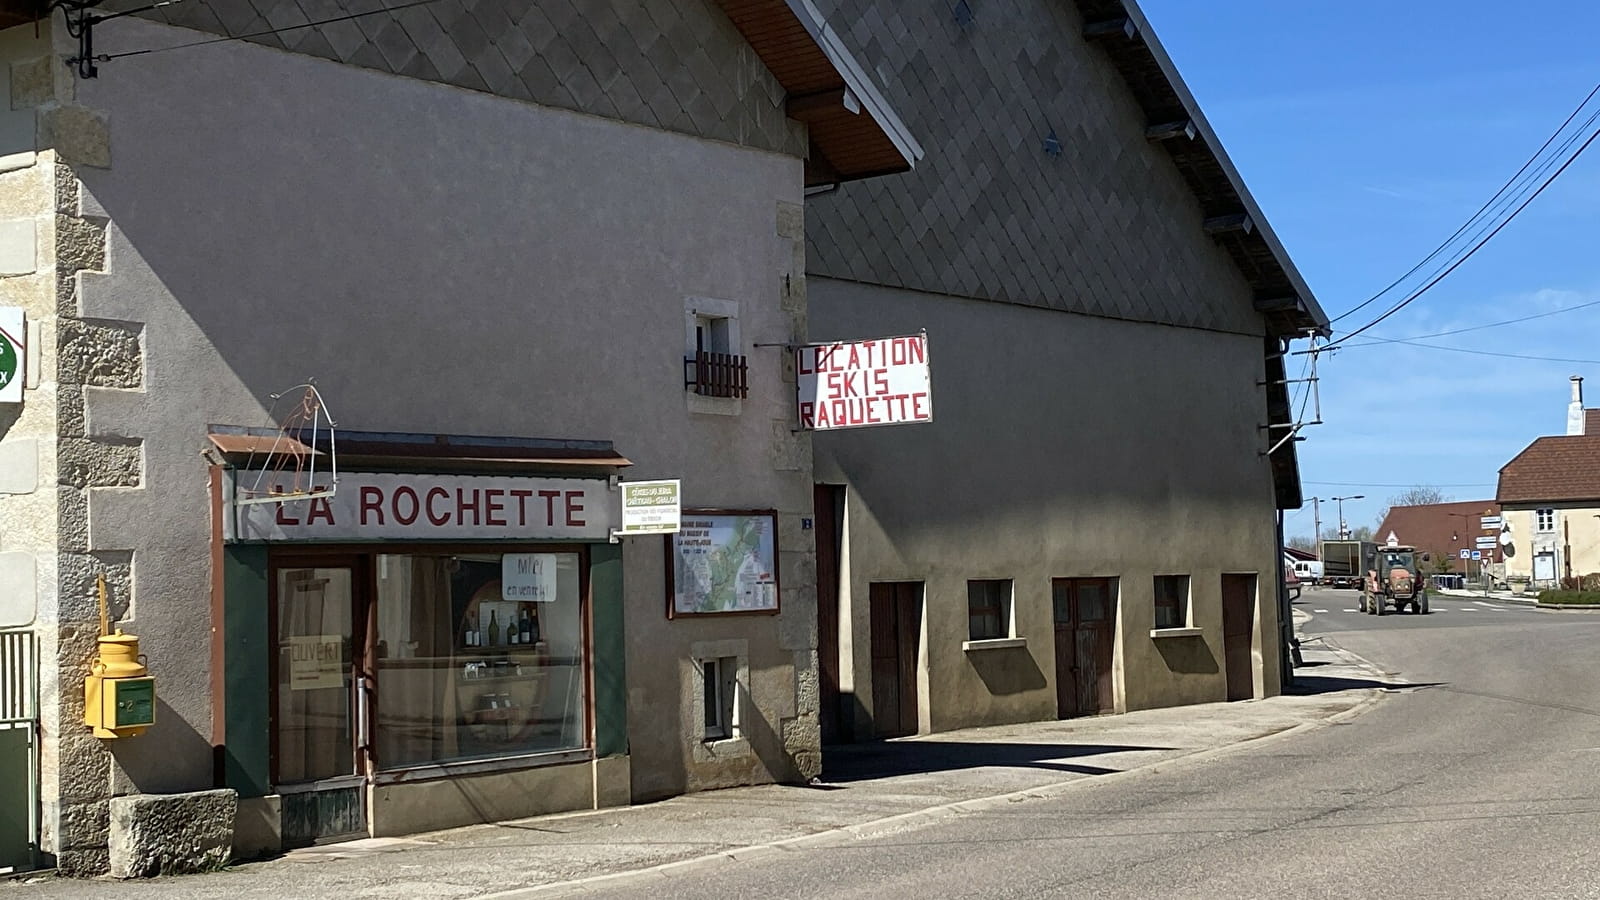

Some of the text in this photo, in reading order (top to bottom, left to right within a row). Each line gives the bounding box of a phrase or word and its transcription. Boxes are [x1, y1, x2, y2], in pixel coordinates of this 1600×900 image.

[800, 337, 924, 375] LOCATION
[827, 368, 889, 399] SKIS
[800, 392, 929, 428] RAQUETTE
[276, 485, 586, 527] LA ROCHETTE
[291, 641, 338, 662] OUVERT
[127, 700, 134, 713] 2
